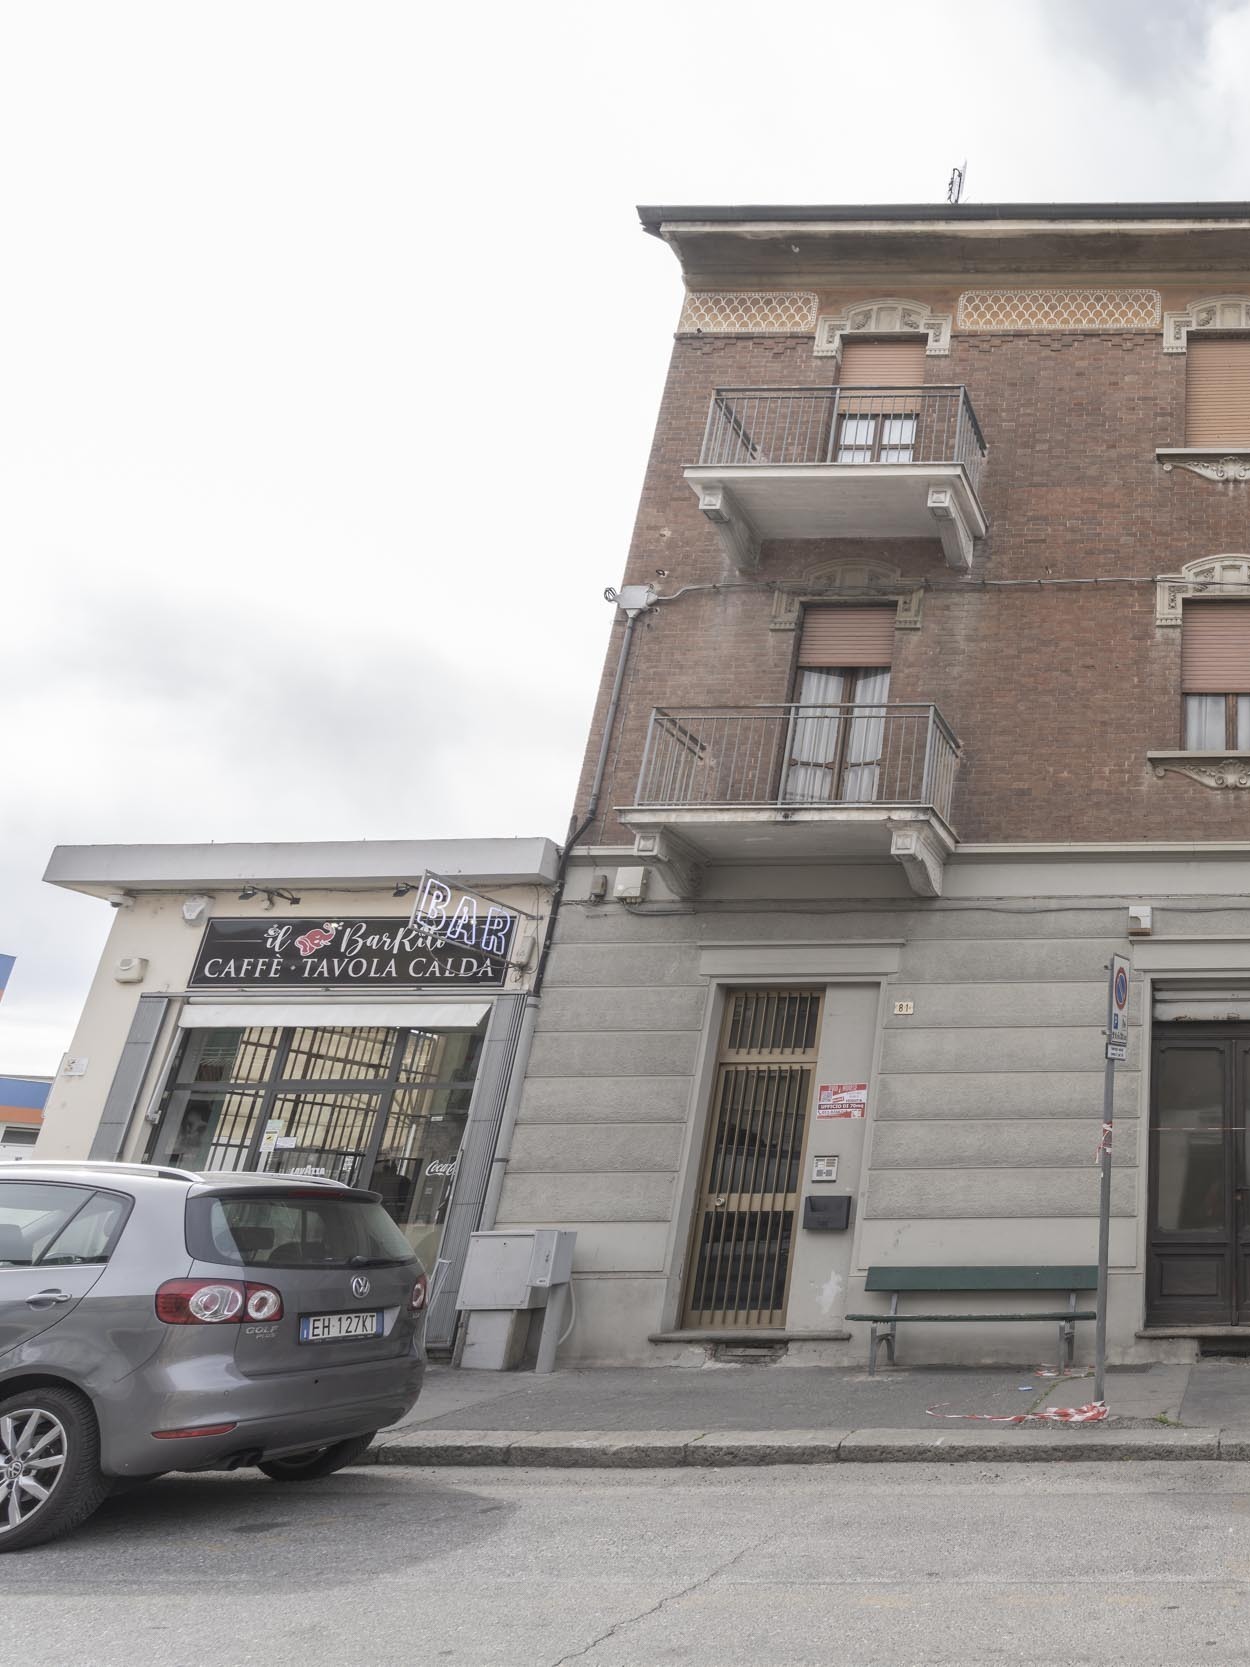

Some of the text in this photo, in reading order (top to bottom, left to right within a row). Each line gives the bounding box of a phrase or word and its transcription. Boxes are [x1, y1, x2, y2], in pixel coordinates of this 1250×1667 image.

[416, 878, 511, 955] BAR
[265, 925, 293, 952] il
[204, 954, 495, 978] CAFFÈ TAVOLA CALDA
[290, 1165, 326, 1175] LAVAZZA
[246, 1325, 279, 1334] GOLF
